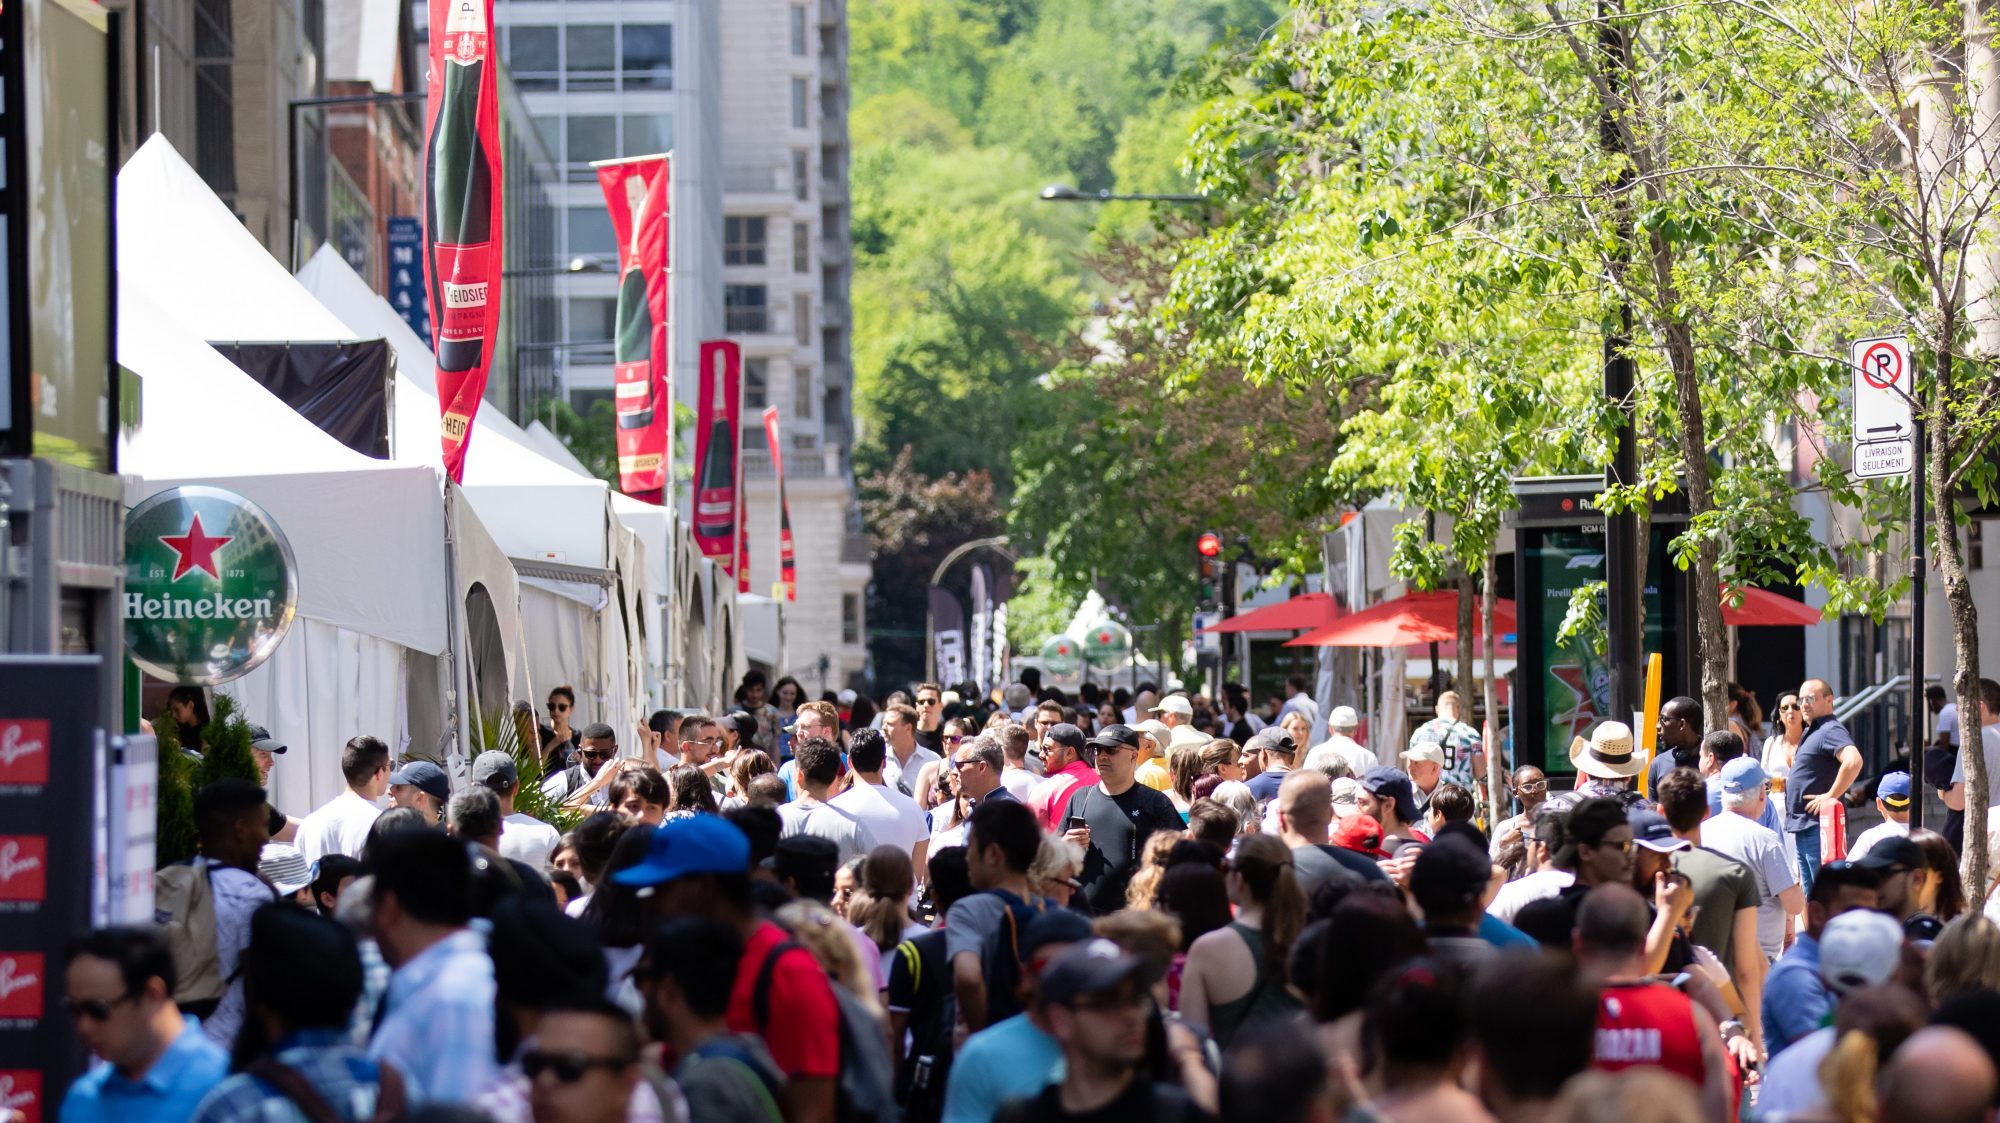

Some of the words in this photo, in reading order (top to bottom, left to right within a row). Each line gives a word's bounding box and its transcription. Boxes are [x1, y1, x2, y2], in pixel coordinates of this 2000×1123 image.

[1865, 446, 1902, 458] LIVRAISON
[1862, 458, 1904, 471] SEULEMENT
[1582, 525, 1598, 533] DCM
[150, 569, 168, 578] EST.
[226, 569, 245, 578] 1873
[122, 592, 273, 619] Heineken
